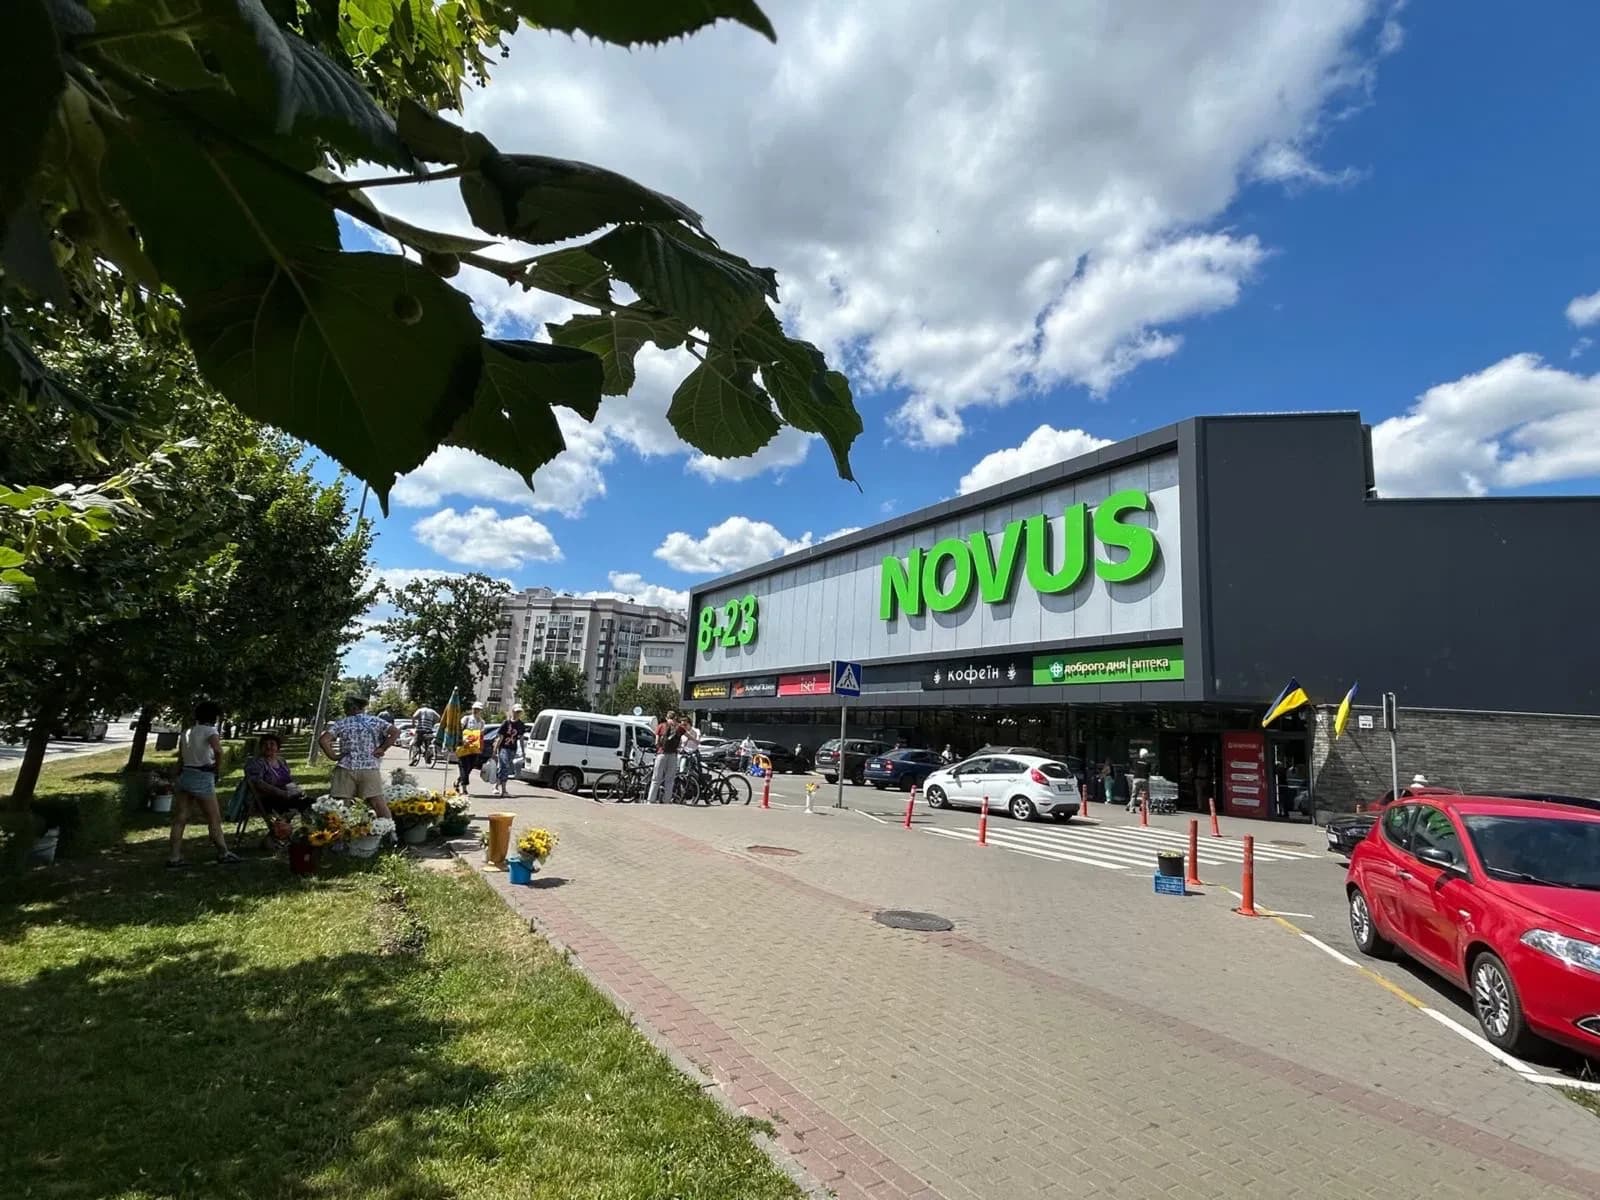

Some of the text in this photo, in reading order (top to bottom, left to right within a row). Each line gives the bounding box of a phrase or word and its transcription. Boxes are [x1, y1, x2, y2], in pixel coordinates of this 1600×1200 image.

[880, 488, 1159, 620] NOVUS
[698, 594, 758, 652] 8-23
[947, 665, 999, 684] кофеїн
[1064, 657, 1169, 674] доброго дня аптека
